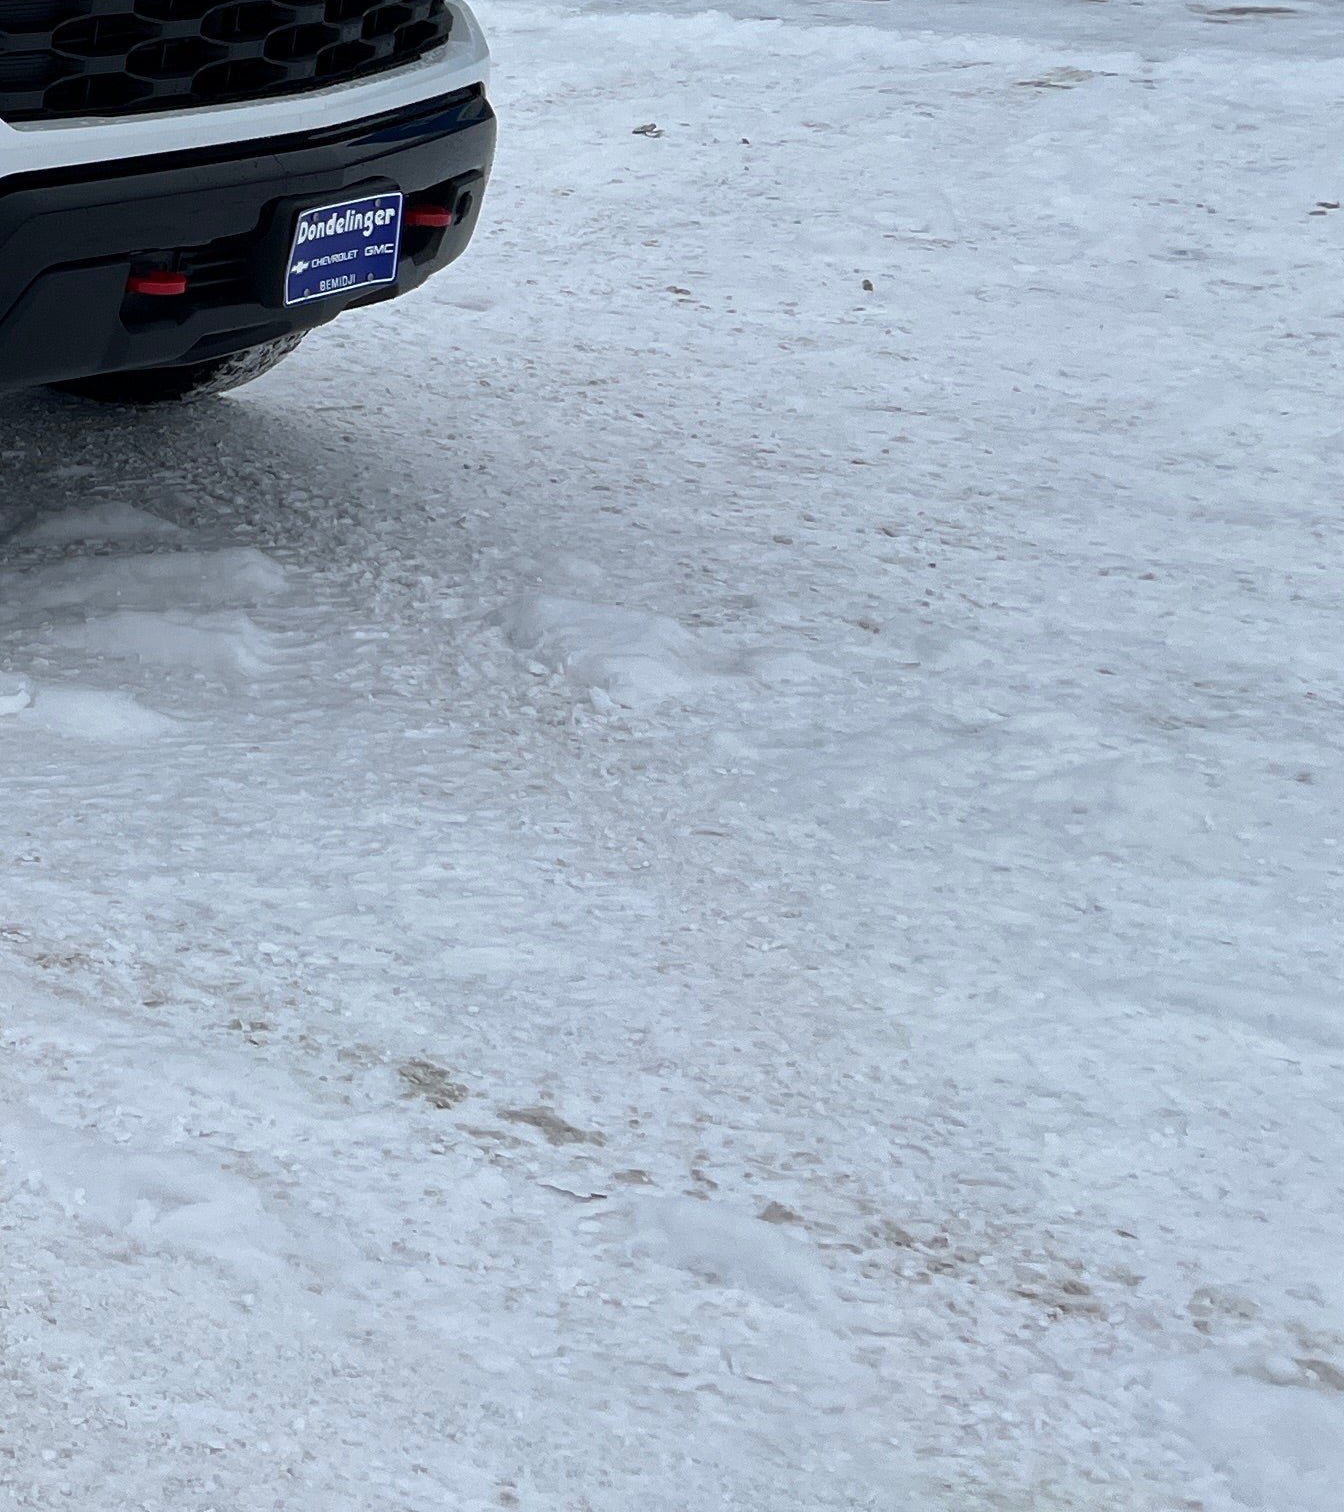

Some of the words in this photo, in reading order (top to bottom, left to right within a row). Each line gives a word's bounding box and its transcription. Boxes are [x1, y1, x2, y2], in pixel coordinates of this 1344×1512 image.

[297, 208, 395, 245] Dondelinger
[311, 250, 358, 268] CHEVROLET
[364, 243, 394, 256] GMC
[319, 274, 355, 291] BEMIDJI
